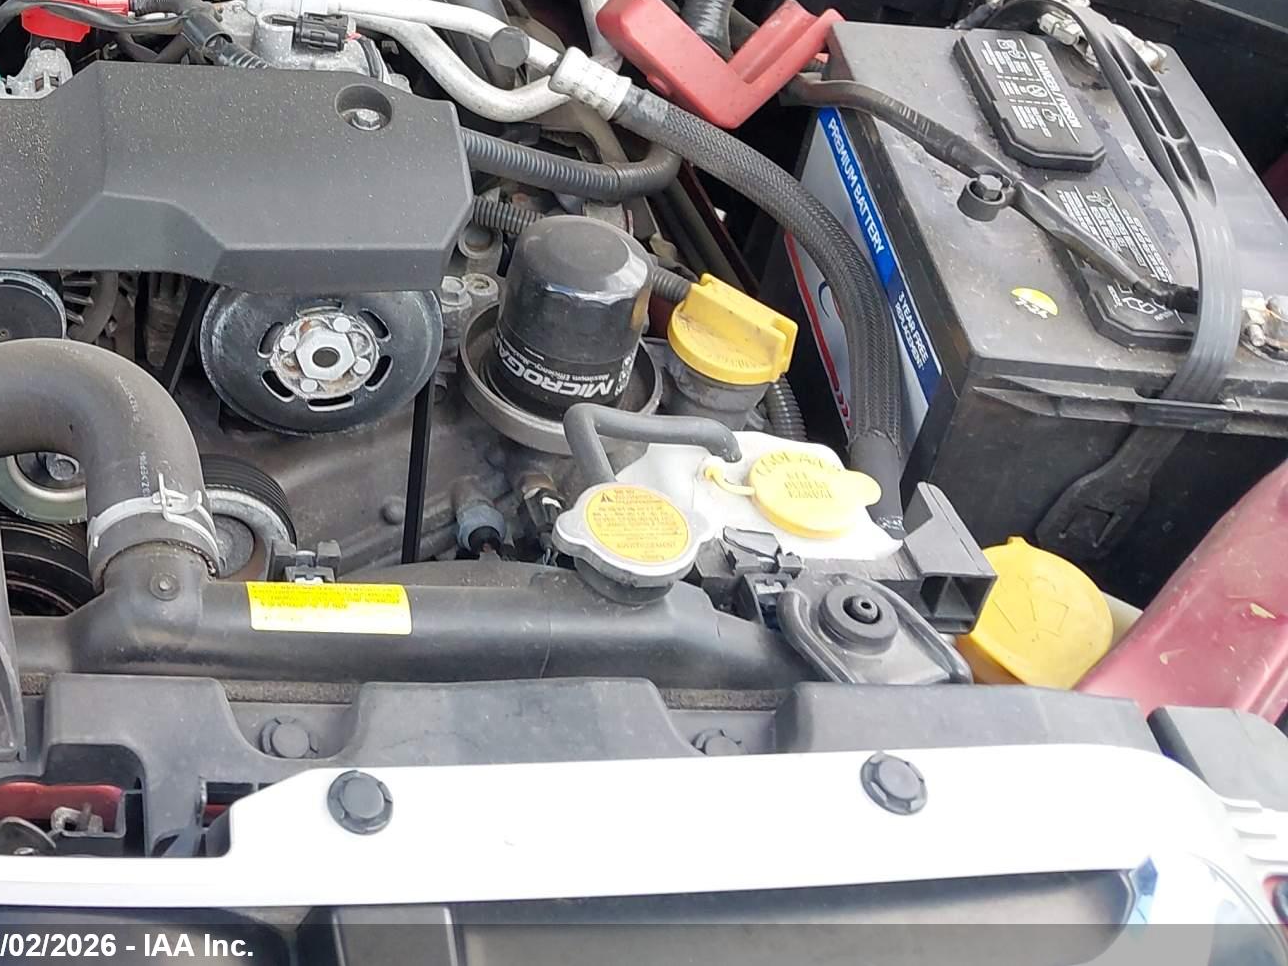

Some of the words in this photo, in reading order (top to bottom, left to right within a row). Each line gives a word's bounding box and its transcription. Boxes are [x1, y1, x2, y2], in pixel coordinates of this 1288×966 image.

[828, 117, 858, 188] PREMIUM
[853, 183, 885, 254] BATTERY
[901, 298, 916, 332] YEAR
[912, 329, 929, 364] FREE
